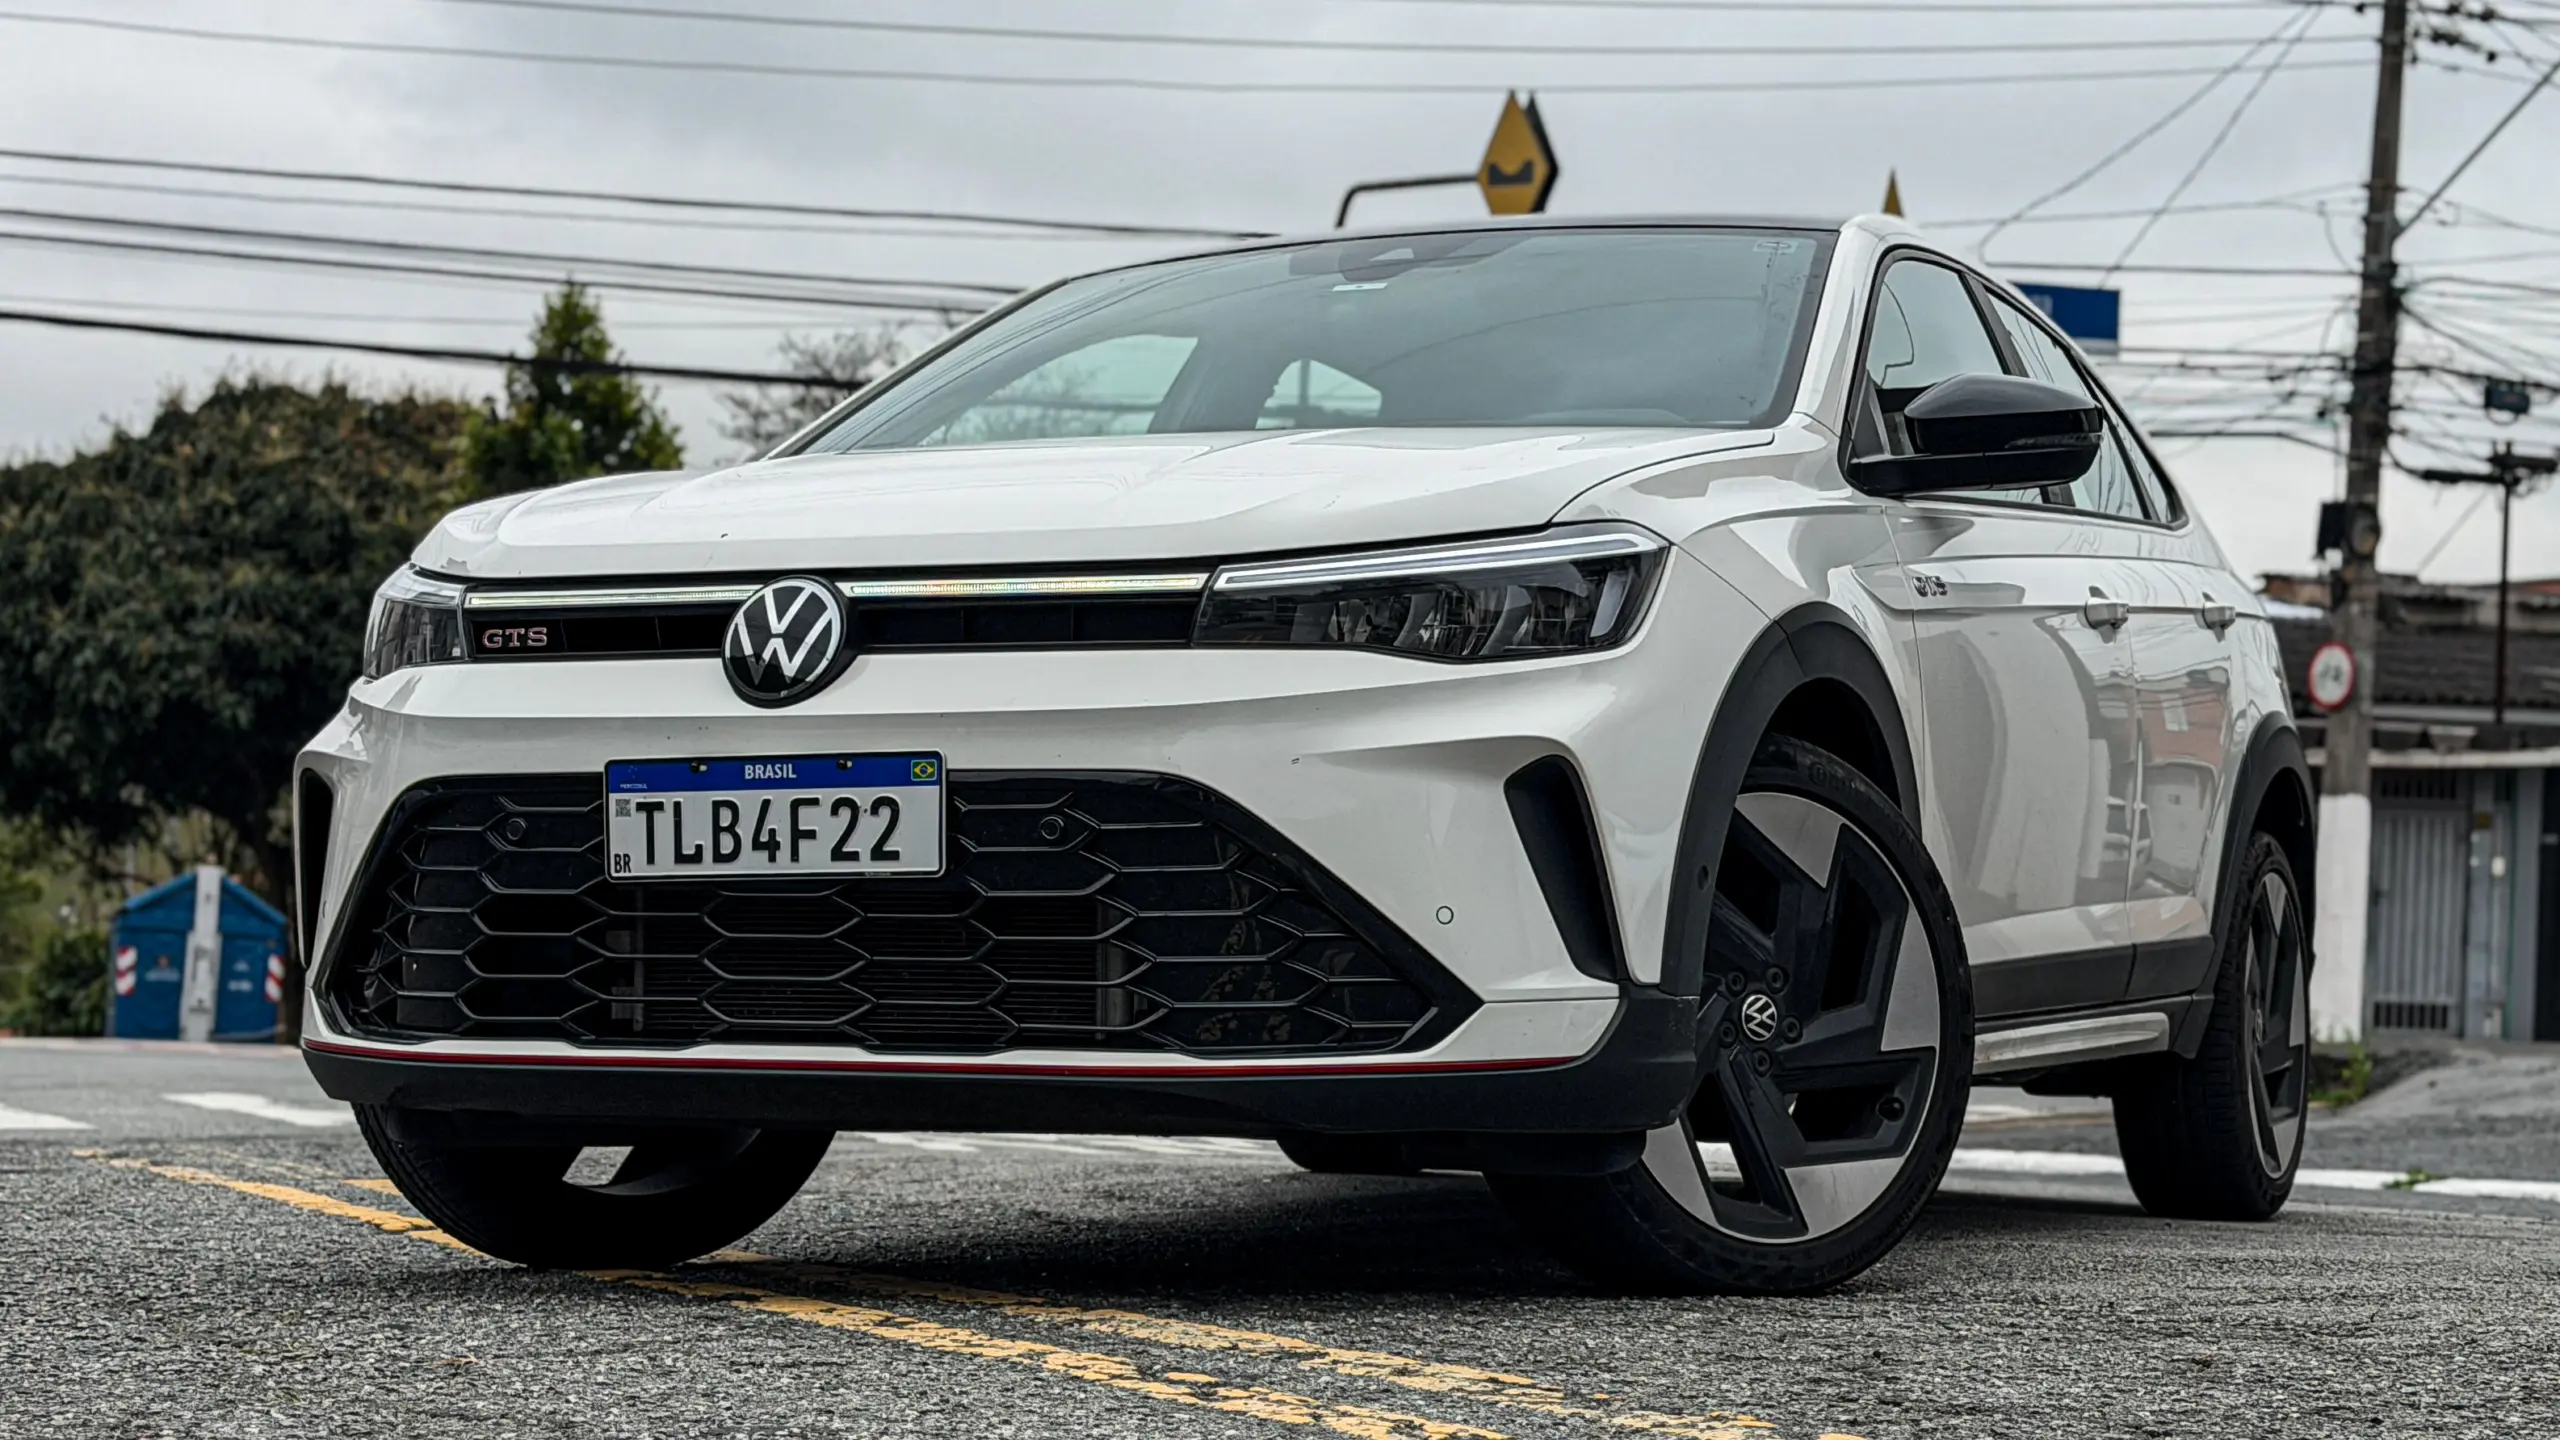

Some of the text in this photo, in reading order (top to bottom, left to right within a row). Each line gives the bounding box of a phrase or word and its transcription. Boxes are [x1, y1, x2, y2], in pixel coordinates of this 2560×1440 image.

[482, 627, 548, 648] GTS
[744, 763, 797, 780] BRASIL
[635, 796, 901, 865] TLB4F22
[613, 853, 632, 874] BR
